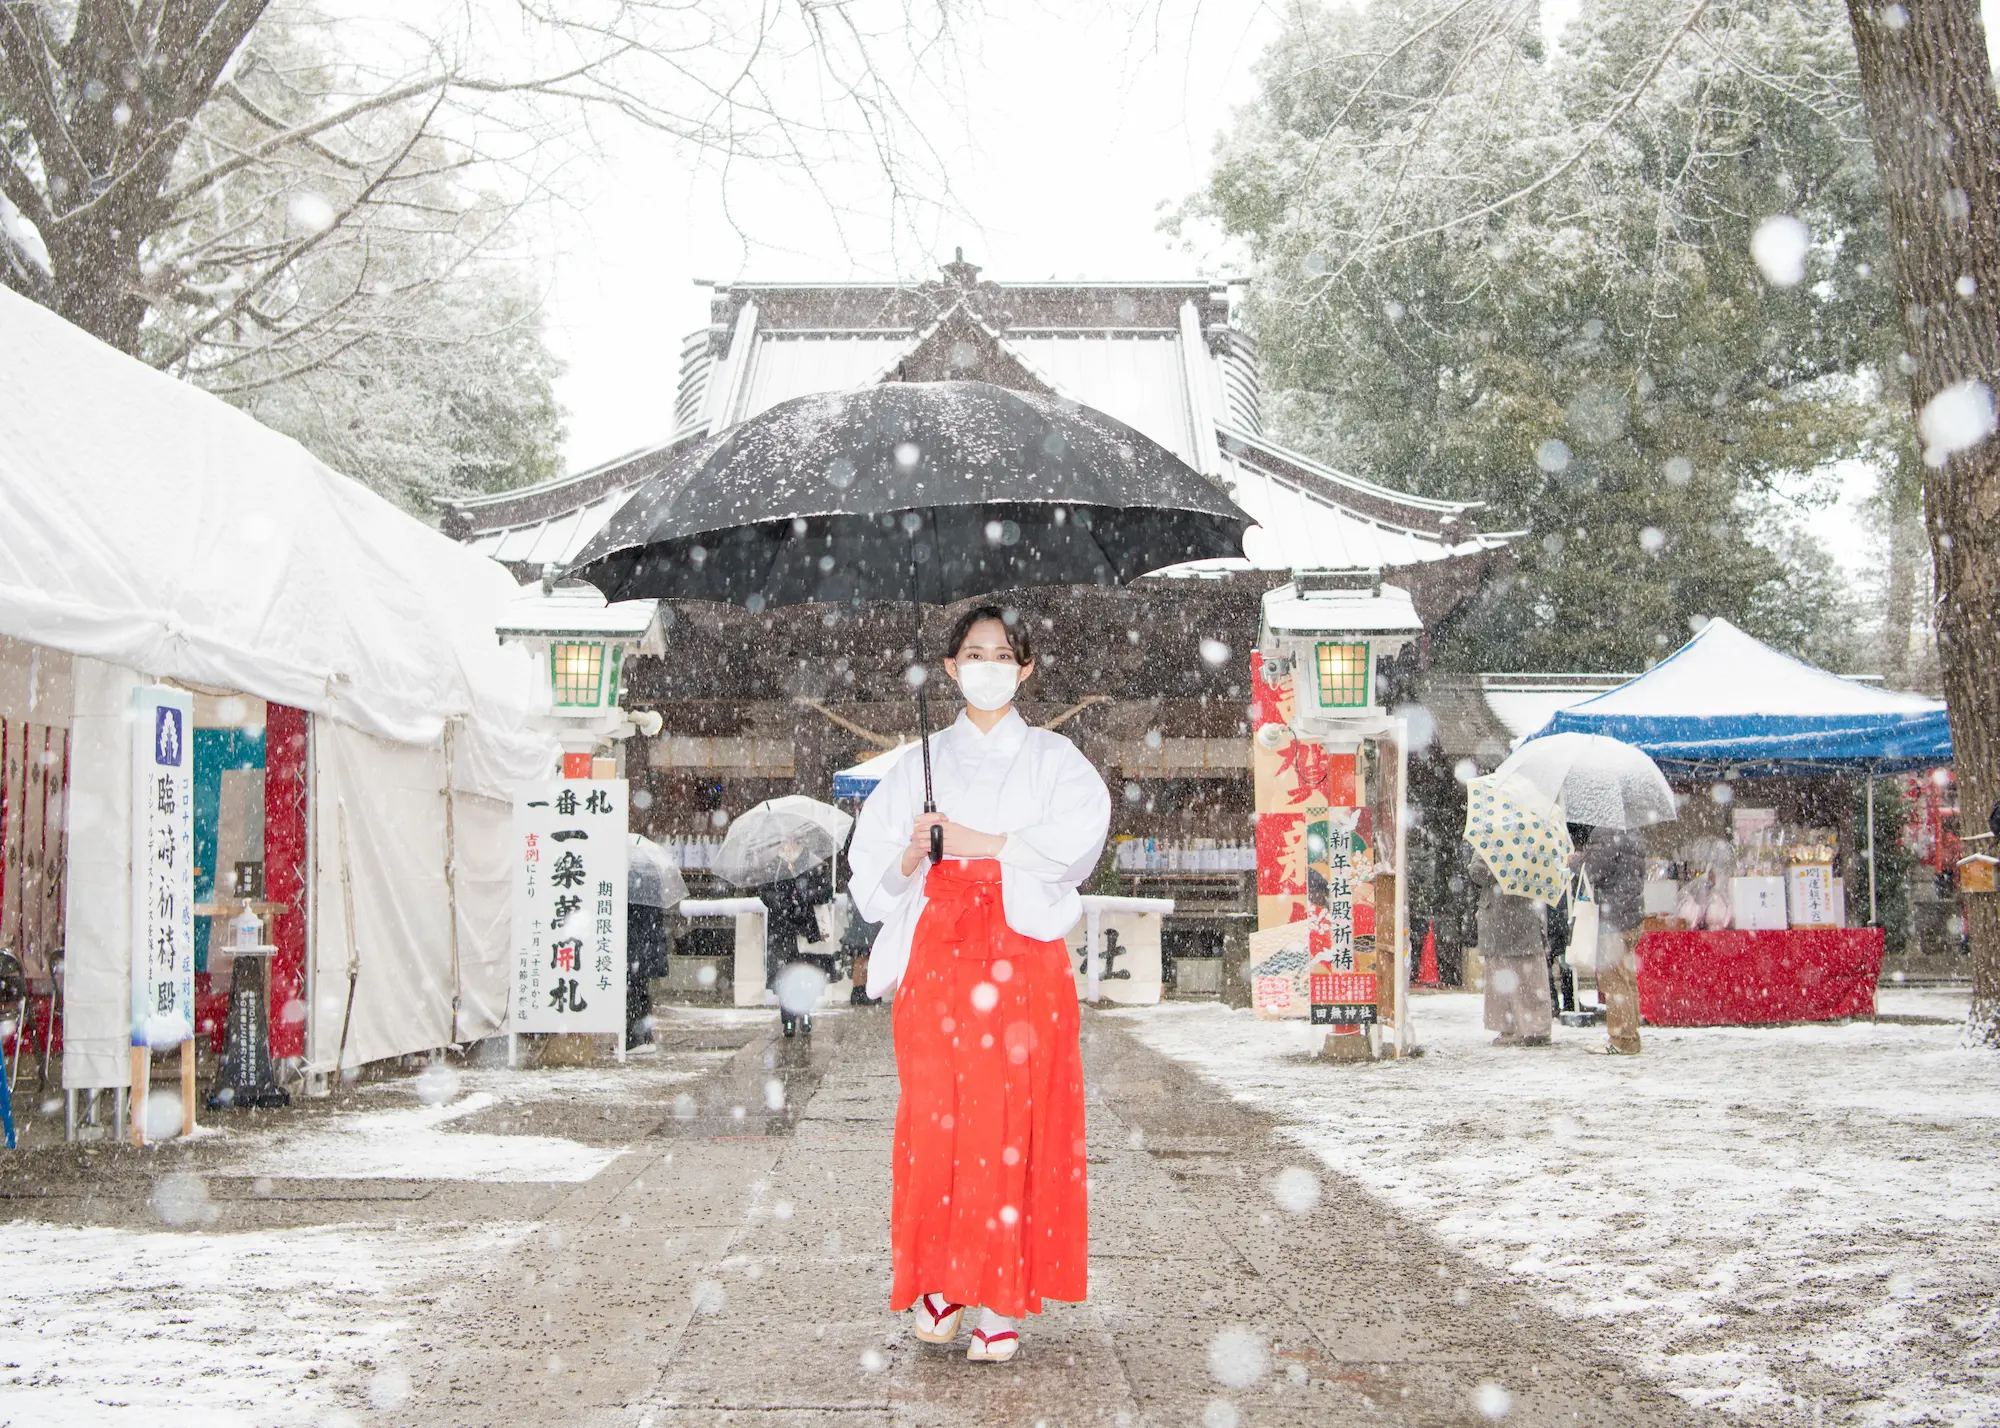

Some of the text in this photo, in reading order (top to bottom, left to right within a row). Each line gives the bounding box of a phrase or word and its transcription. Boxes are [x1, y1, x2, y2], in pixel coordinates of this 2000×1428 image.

[527, 788, 614, 816] 一番札
[525, 832, 540, 899] 吉例により
[1330, 829, 1354, 971] 新年社殿祈祷
[595, 880, 614, 991] 期間限定授与
[1315, 1006, 1372, 1020] 田無神社
